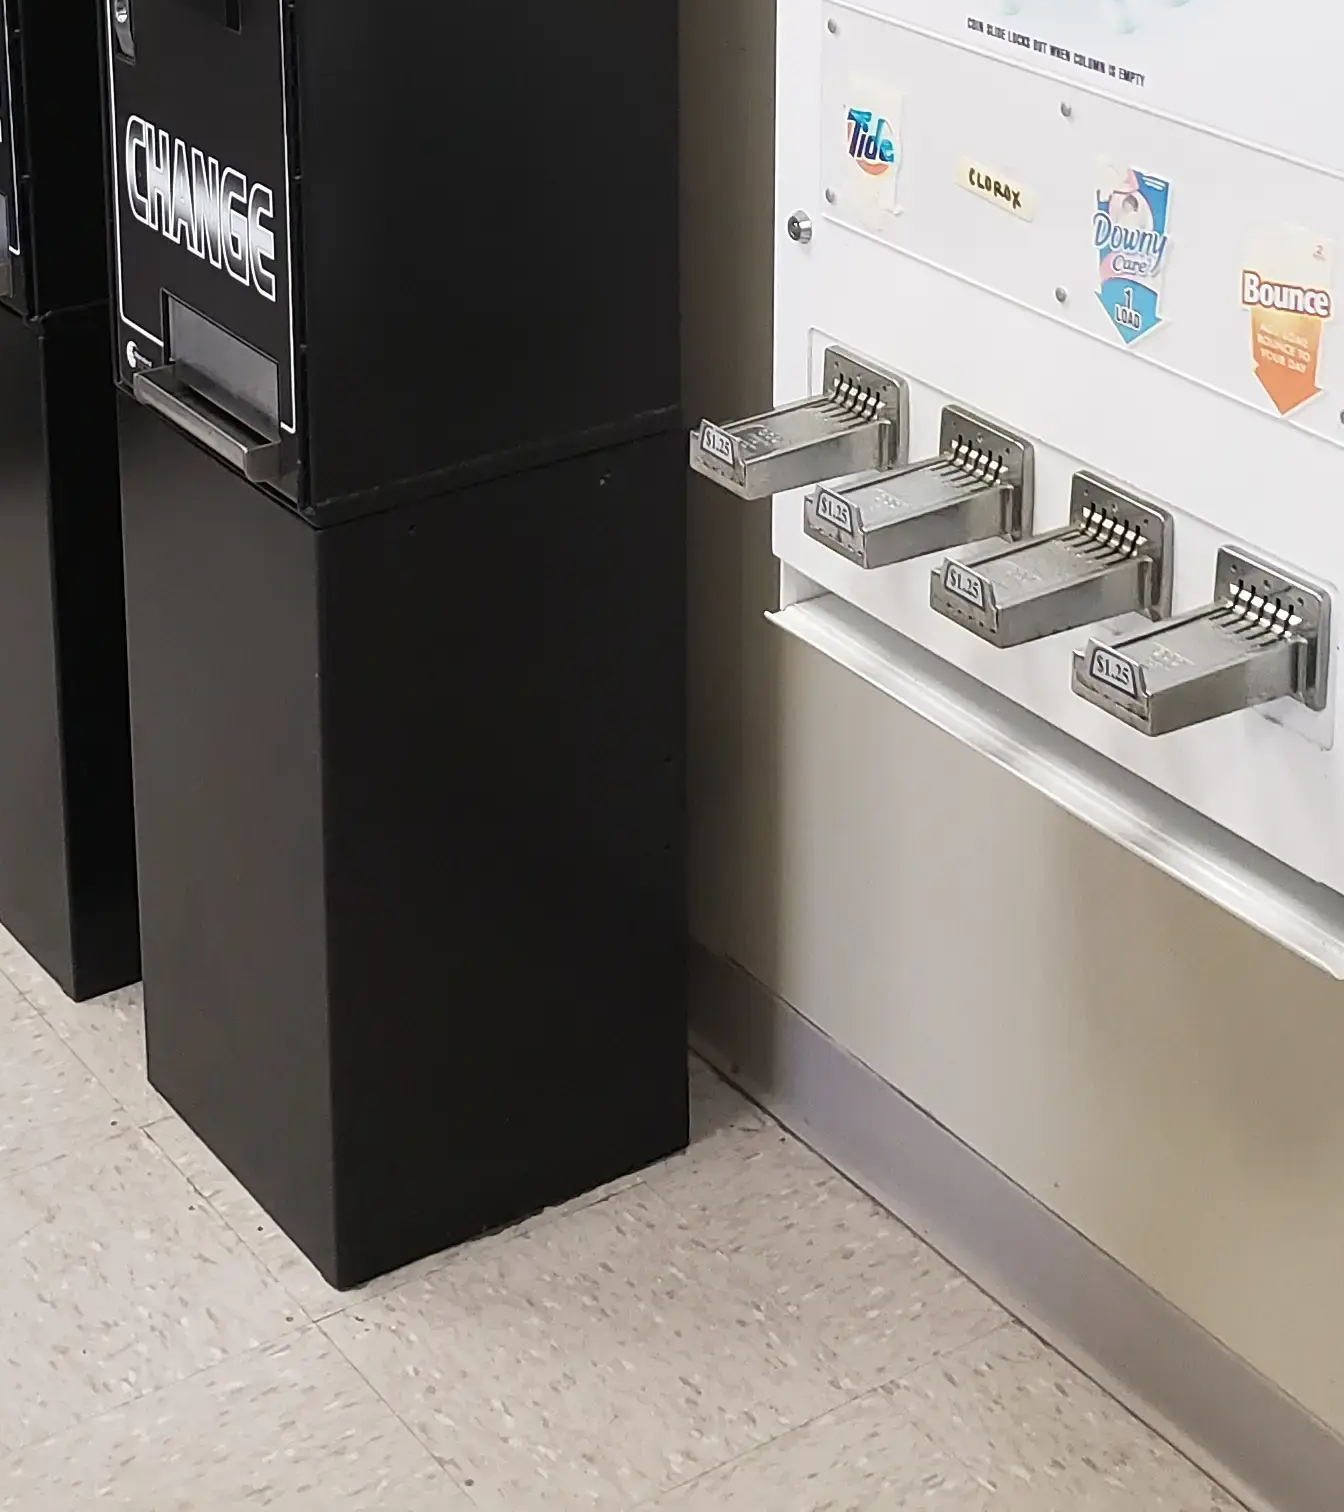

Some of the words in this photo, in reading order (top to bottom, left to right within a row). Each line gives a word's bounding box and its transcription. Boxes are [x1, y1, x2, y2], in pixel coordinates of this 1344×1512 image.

[967, 17, 983, 33] COIN
[986, 24, 1005, 40] SLIDE
[1008, 30, 1030, 48] LOCKS
[1033, 39, 1047, 55] OUT
[1050, 44, 1070, 61] WHEN
[1109, 64, 1116, 77] IS
[1119, 67, 1145, 87] EMPTY
[847, 107, 894, 163] Tide
[969, 167, 1022, 209] CLOROX
[126, 115, 276, 302] CHANGE
[1093, 211, 1167, 275] Downy
[1124, 289, 1131, 309] 1
[1242, 269, 1331, 318] Bounce
[1116, 308, 1140, 329] LOAD
[706, 430, 730, 455] $1.25
[821, 496, 847, 524] $1.25
[949, 570, 979, 598] $1.25
[1095, 654, 1129, 686] $1.25
